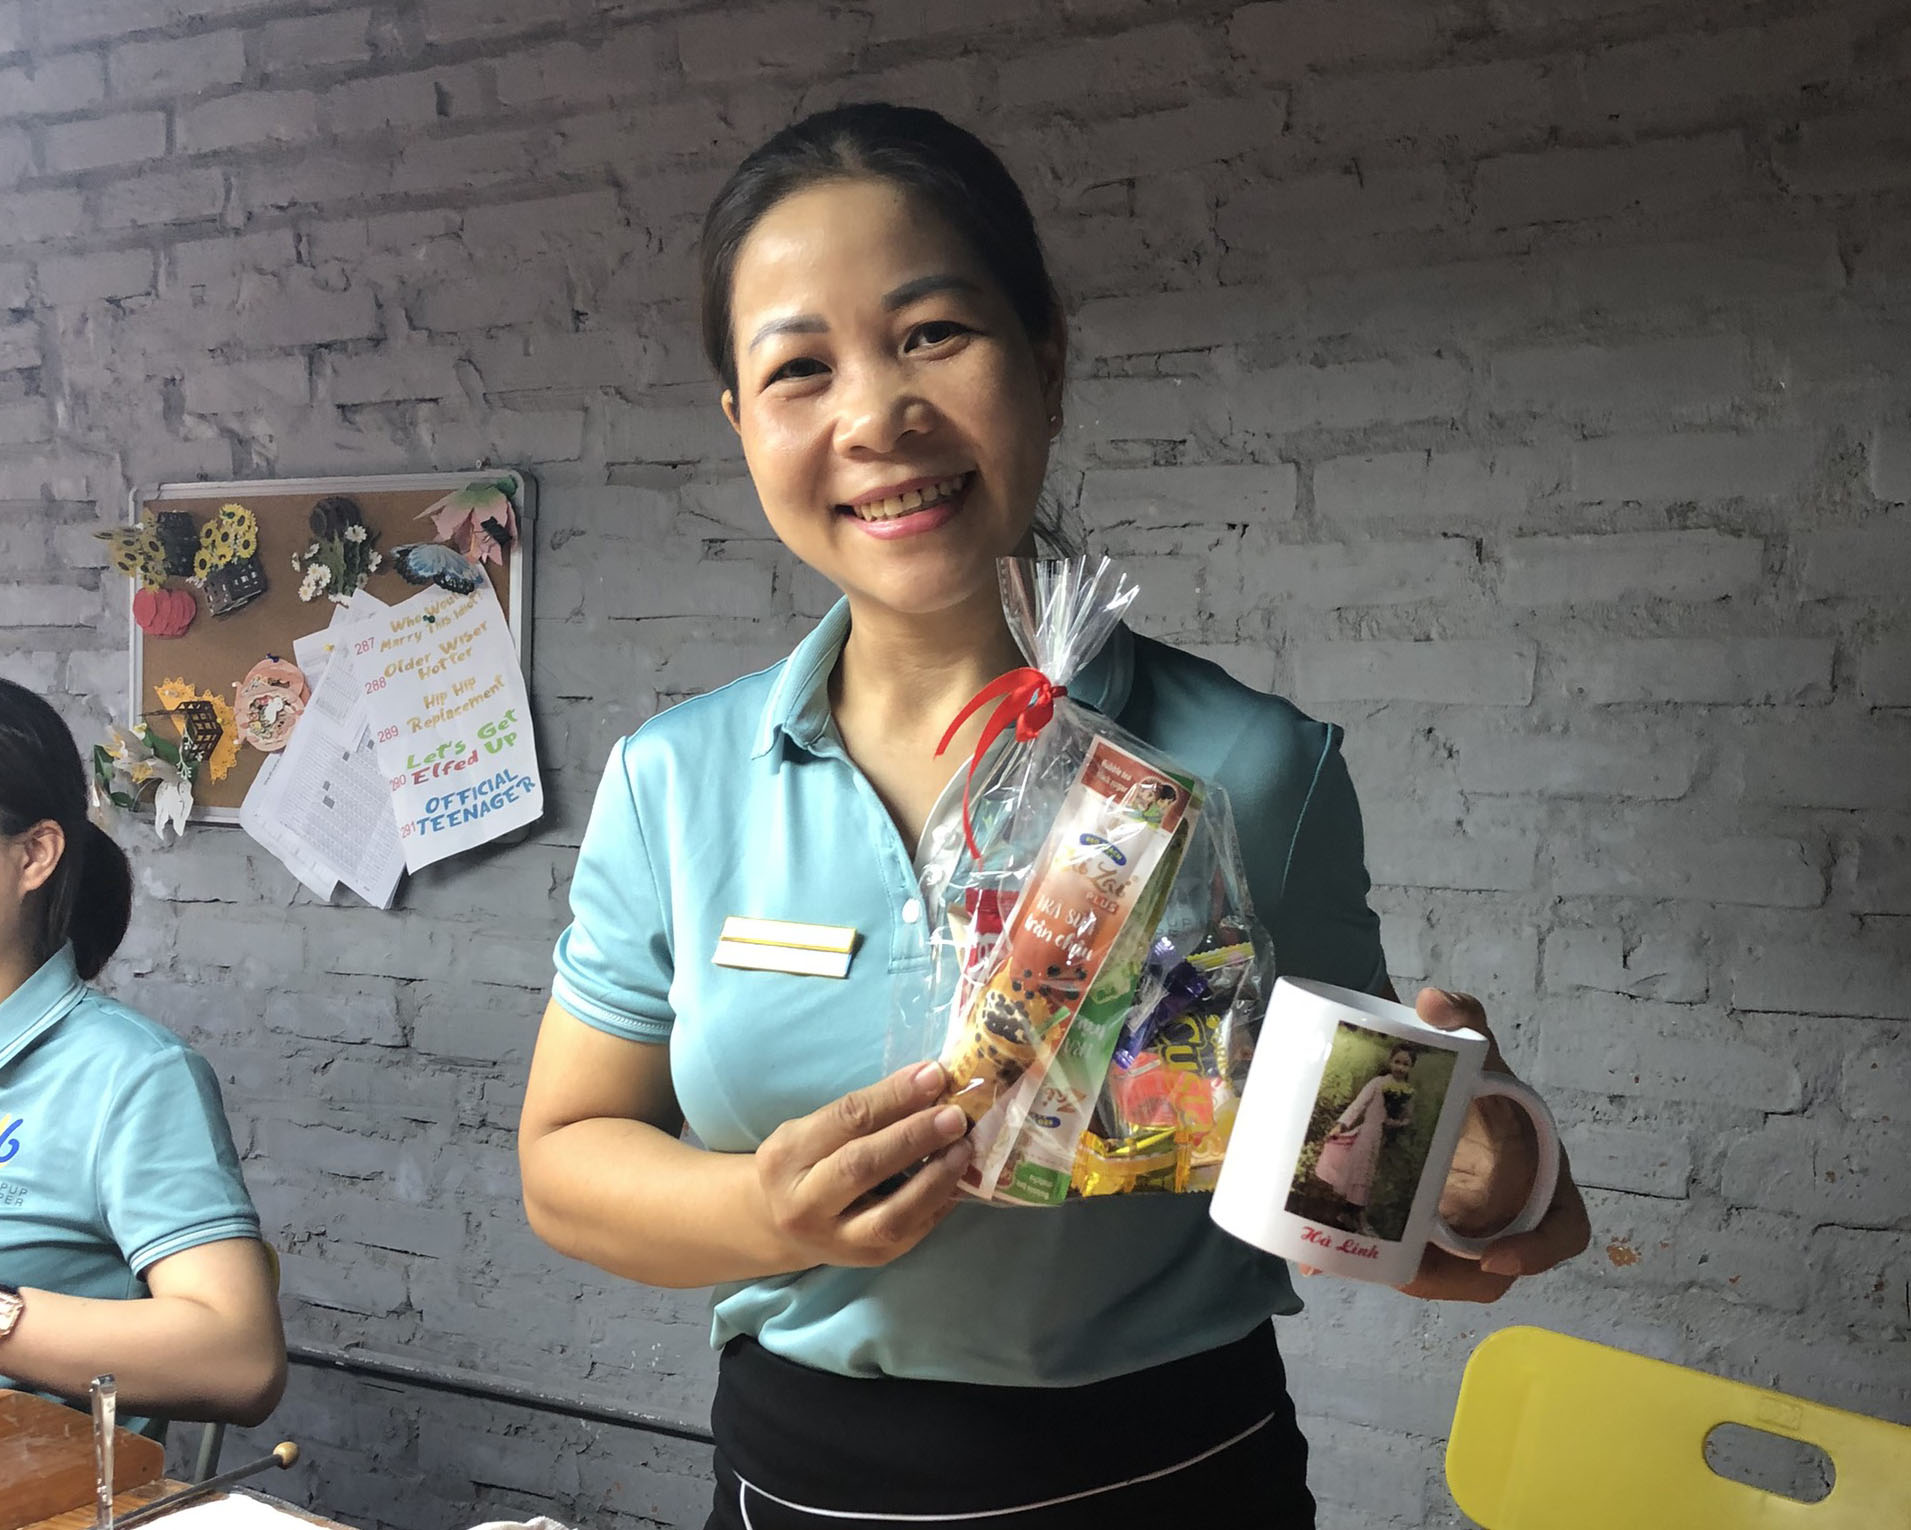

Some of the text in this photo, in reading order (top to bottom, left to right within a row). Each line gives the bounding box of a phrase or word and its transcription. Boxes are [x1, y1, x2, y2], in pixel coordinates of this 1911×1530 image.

[390, 613, 421, 633] Who
[354, 637, 375, 656] 287
[380, 631, 422, 652] Marry
[384, 621, 487, 678] Older Wiser
[418, 647, 472, 680] Hotter
[364, 677, 387, 695] 288
[423, 676, 476, 710] Hip Hip
[406, 674, 505, 733] Replacement
[377, 724, 399, 743] 289
[406, 709, 518, 770] Let's Get
[411, 749, 479, 785] Elfed
[425, 768, 519, 814] OFFICIAL
[416, 776, 536, 836] TEENAGER
[400, 821, 417, 839] 291
[1086, 891, 1119, 914] PLUS
[1336, 1239, 1379, 1259] Linh
